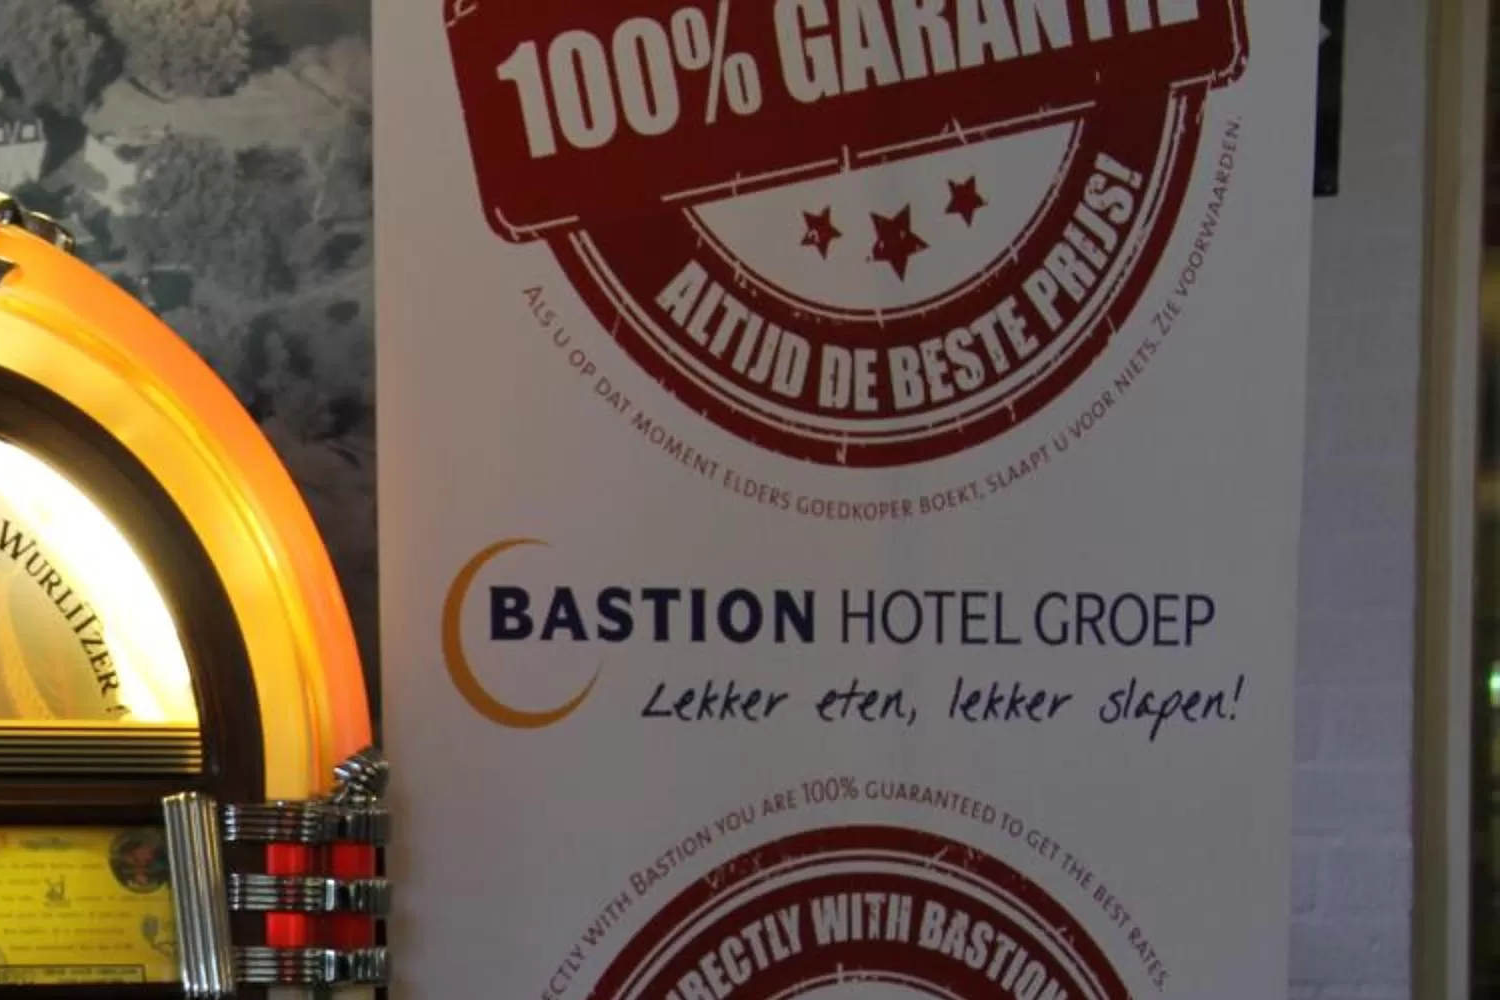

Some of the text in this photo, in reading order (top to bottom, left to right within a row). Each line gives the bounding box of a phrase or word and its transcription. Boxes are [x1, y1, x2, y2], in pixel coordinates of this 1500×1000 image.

[496, 0, 1200, 159] 100% GARA
[552, 324, 572, 349] U
[568, 347, 597, 378] OP
[594, 376, 633, 416] DAT
[631, 406, 721, 481] MOMENT
[723, 468, 792, 512] ELDERS
[795, 495, 913, 522] GOEDKOPER
[985, 444, 1050, 494] SLAAPT
[1052, 433, 1071, 454] U
[1066, 390, 1115, 441] VOOR
[1113, 336, 1158, 397] NIETS.
[1174, 114, 1243, 298] VOORWAARDEN.
[654, 151, 1145, 412] ALTIJD DE BESTE PRIJS!
[488, 586, 1216, 648] BASTION HOTEL GROEP
[641, 675, 1245, 741] Lekker eten, lekker slapen!
[580, 890, 633, 948] WITH
[627, 825, 713, 898] BASTION
[714, 801, 756, 838] YOU
[761, 788, 799, 818] ARE
[801, 776, 860, 805] 100%
[864, 780, 997, 825] GUARANTEED
[1000, 811, 1025, 838] TO
[1026, 829, 1061, 863] GET
[1060, 851, 1096, 891] THE
[1092, 883, 1132, 931] BEST
[809, 891, 913, 946] WITH
